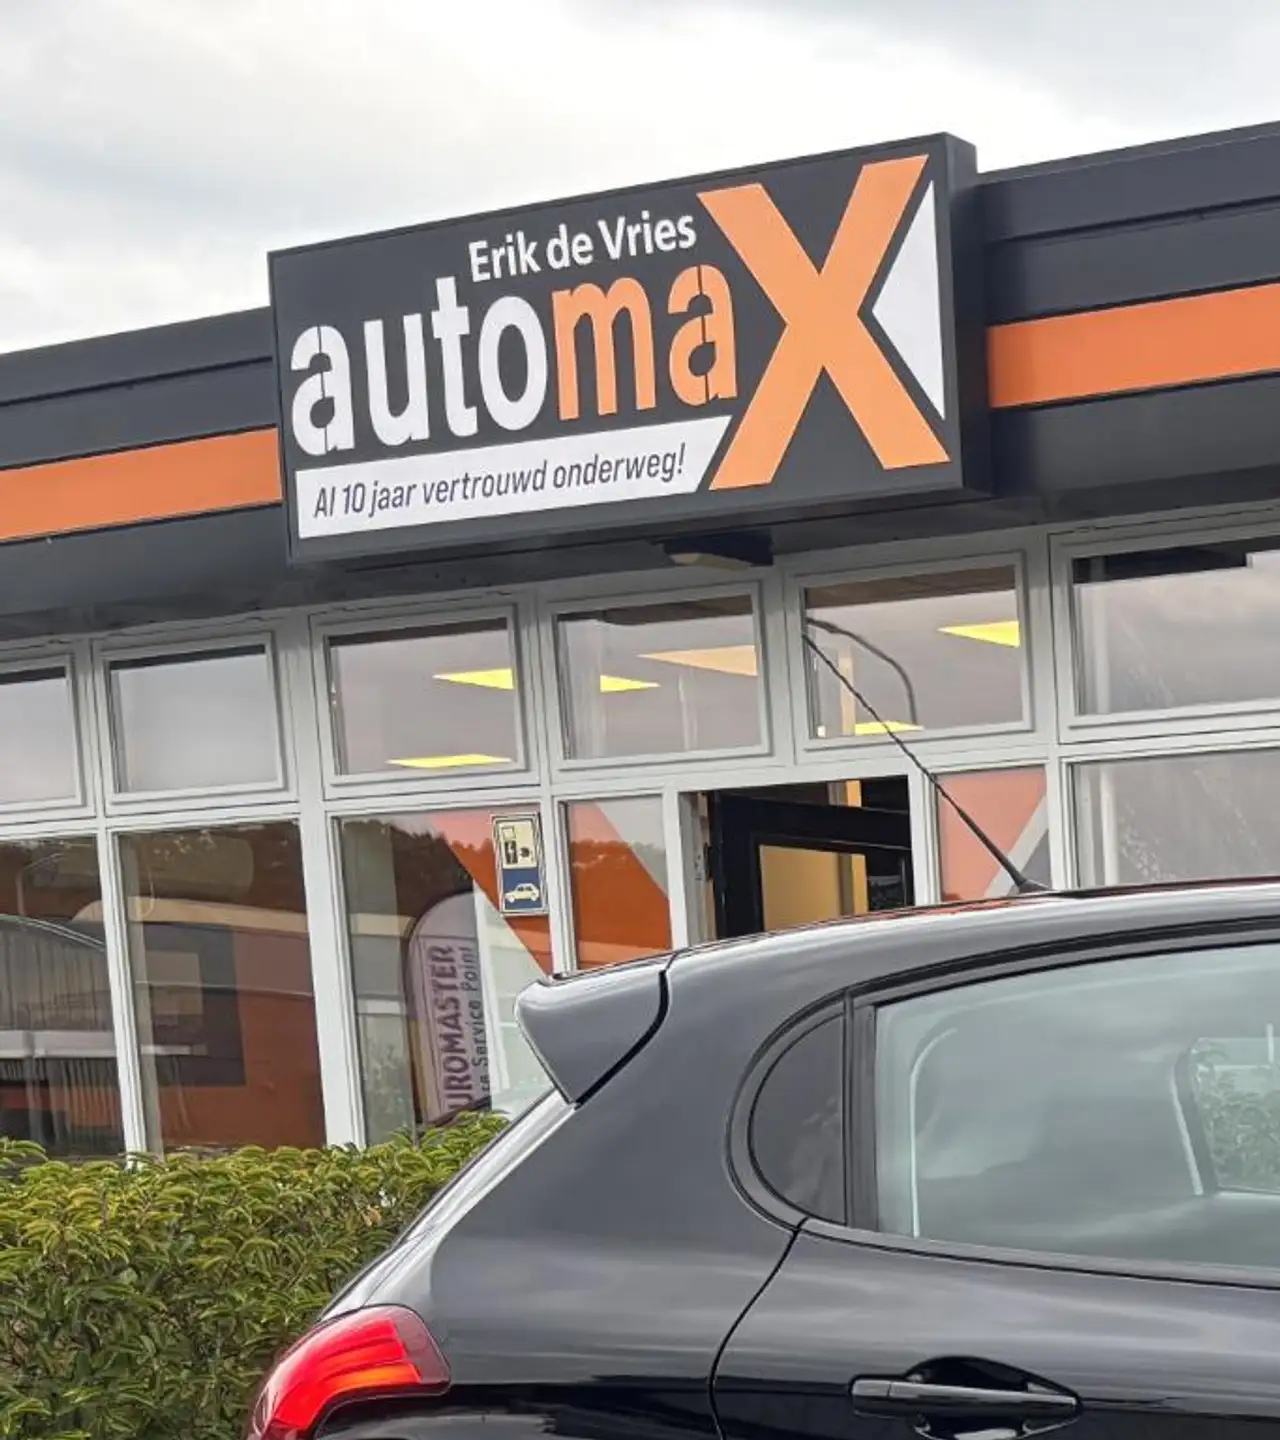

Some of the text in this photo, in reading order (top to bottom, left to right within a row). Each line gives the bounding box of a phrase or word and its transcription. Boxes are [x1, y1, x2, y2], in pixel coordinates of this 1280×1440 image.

[468, 209, 698, 283] Erik de Vries
[291, 153, 951, 490] automaX
[313, 442, 687, 518] Al 10 jaar vertrouwd onderweg!
[428, 944, 474, 1108] UROMASTER
